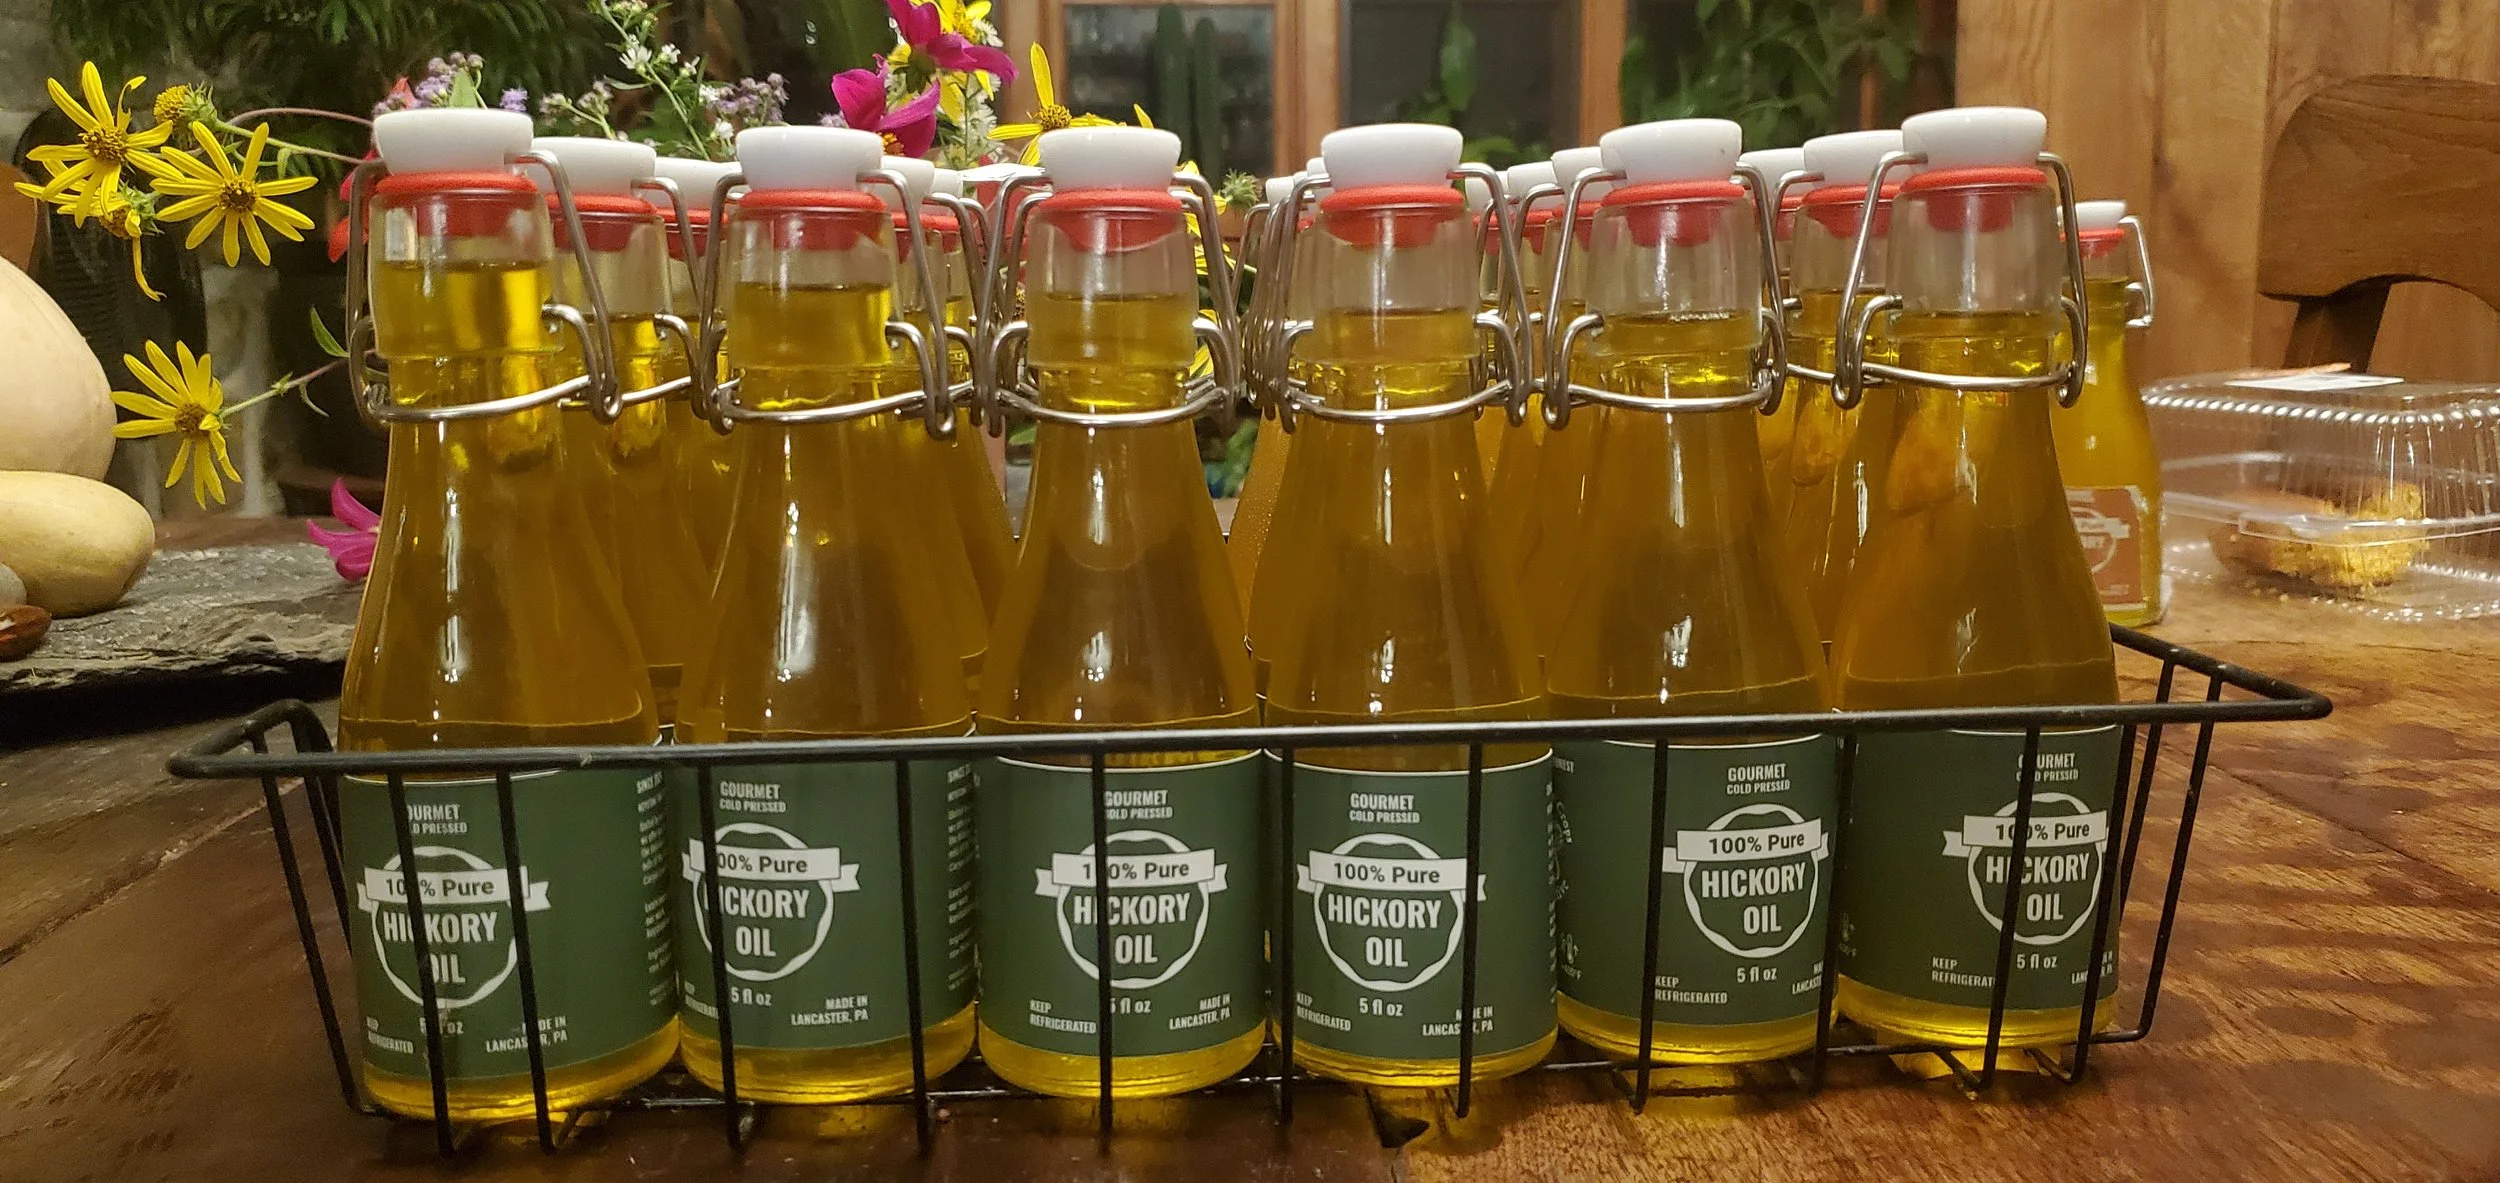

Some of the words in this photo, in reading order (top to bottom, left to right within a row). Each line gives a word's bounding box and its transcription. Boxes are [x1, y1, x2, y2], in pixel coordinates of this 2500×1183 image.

[1728, 763, 1786, 782] GOURMET
[2043, 769, 2079, 782] PRESSED
[720, 781, 781, 800] GOURMET
[1726, 783, 1751, 795] COLD
[1754, 779, 1790, 794] PRESSED
[1104, 790, 1168, 807] GOURMET
[1350, 793, 1414, 811] GOURMET
[407, 804, 460, 820] OURMET
[1130, 807, 1174, 819] PRESSED
[1349, 810, 1374, 823] COLD
[1376, 811, 1420, 824] PRESSED
[422, 822, 468, 834] PRESSED
[2054, 823, 2090, 840] Pure
[1709, 836, 1762, 854] 100%
[1768, 833, 1805, 852] Pure
[718, 853, 752, 872] 00%
[759, 856, 808, 873] Pure
[1083, 862, 1137, 880] 10%
[1145, 863, 1189, 879] Pure
[1334, 862, 1385, 882] 100%
[1392, 866, 1440, 883] Pure
[1701, 861, 1806, 899] HICKORY
[386, 878, 436, 897] 10%
[442, 879, 494, 896] Pure
[1327, 892, 1442, 929] HICKORY
[2026, 893, 2064, 922] OIL
[1743, 904, 1782, 935] OIL
[735, 926, 777, 957] OIL
[1114, 934, 1159, 964] OIL
[1365, 936, 1408, 968] OIL
[2016, 953, 2025, 969] 5
[2030, 953, 2039, 969] fl
[2043, 955, 2057, 969] oz
[1932, 956, 1958, 970] KEEP
[1655, 976, 1679, 988] KEEP
[1737, 967, 1746, 983] 5
[1750, 965, 1759, 982] fl
[1763, 967, 1777, 981] oz
[1932, 970, 1996, 988] REFRIGERAT
[731, 987, 739, 1003] 5
[742, 988, 753, 1005] fl
[756, 993, 772, 1007] oz
[825, 997, 855, 1010] MADE
[857, 995, 869, 1007] IN
[1199, 995, 1222, 1011] MADE
[1655, 988, 1728, 1004] REFRIGERATED
[854, 1008, 869, 1021] PA
[1029, 999, 1052, 1013] KEEP
[1120, 998, 1131, 1013] fl
[1134, 1000, 1151, 1014] oz
[1220, 1007, 1230, 1020] PA
[1359, 997, 1368, 1014] 5
[1372, 998, 1382, 1016] fl
[1386, 1003, 1403, 1017] oz
[1484, 1006, 1493, 1018] IN
[555, 1015, 566, 1027] IN
[1029, 1013, 1097, 1034] REFRIGERATED
[1296, 1005, 1351, 1031] REFRIGERATED
[1482, 1019, 1493, 1031] PA
[486, 1034, 550, 1053] LANCASR,
[554, 1029, 567, 1042] PA
